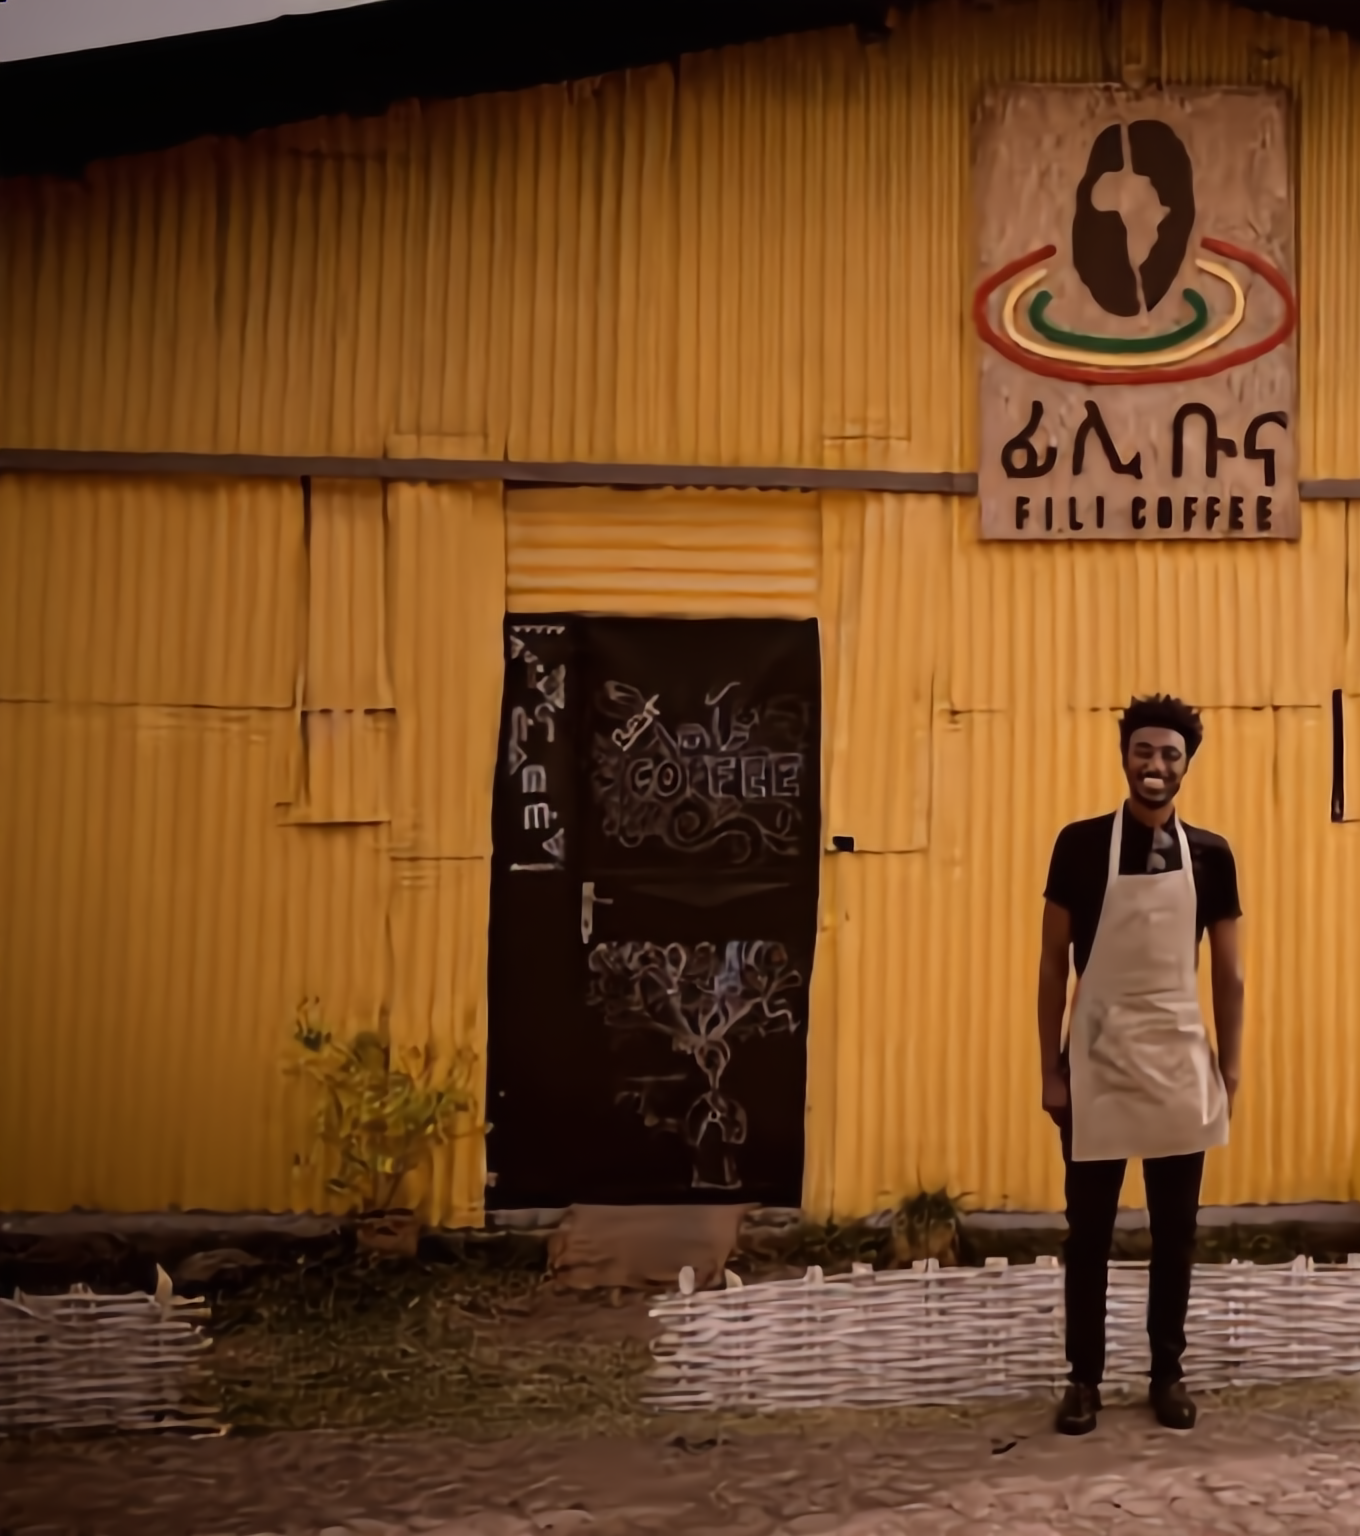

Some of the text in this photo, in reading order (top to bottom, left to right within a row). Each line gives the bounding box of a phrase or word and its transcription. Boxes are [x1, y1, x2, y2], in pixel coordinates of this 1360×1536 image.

[1001, 400, 1288, 487] ፊሊ ቡና
[1015, 496, 1273, 532] FILI COFFEE
